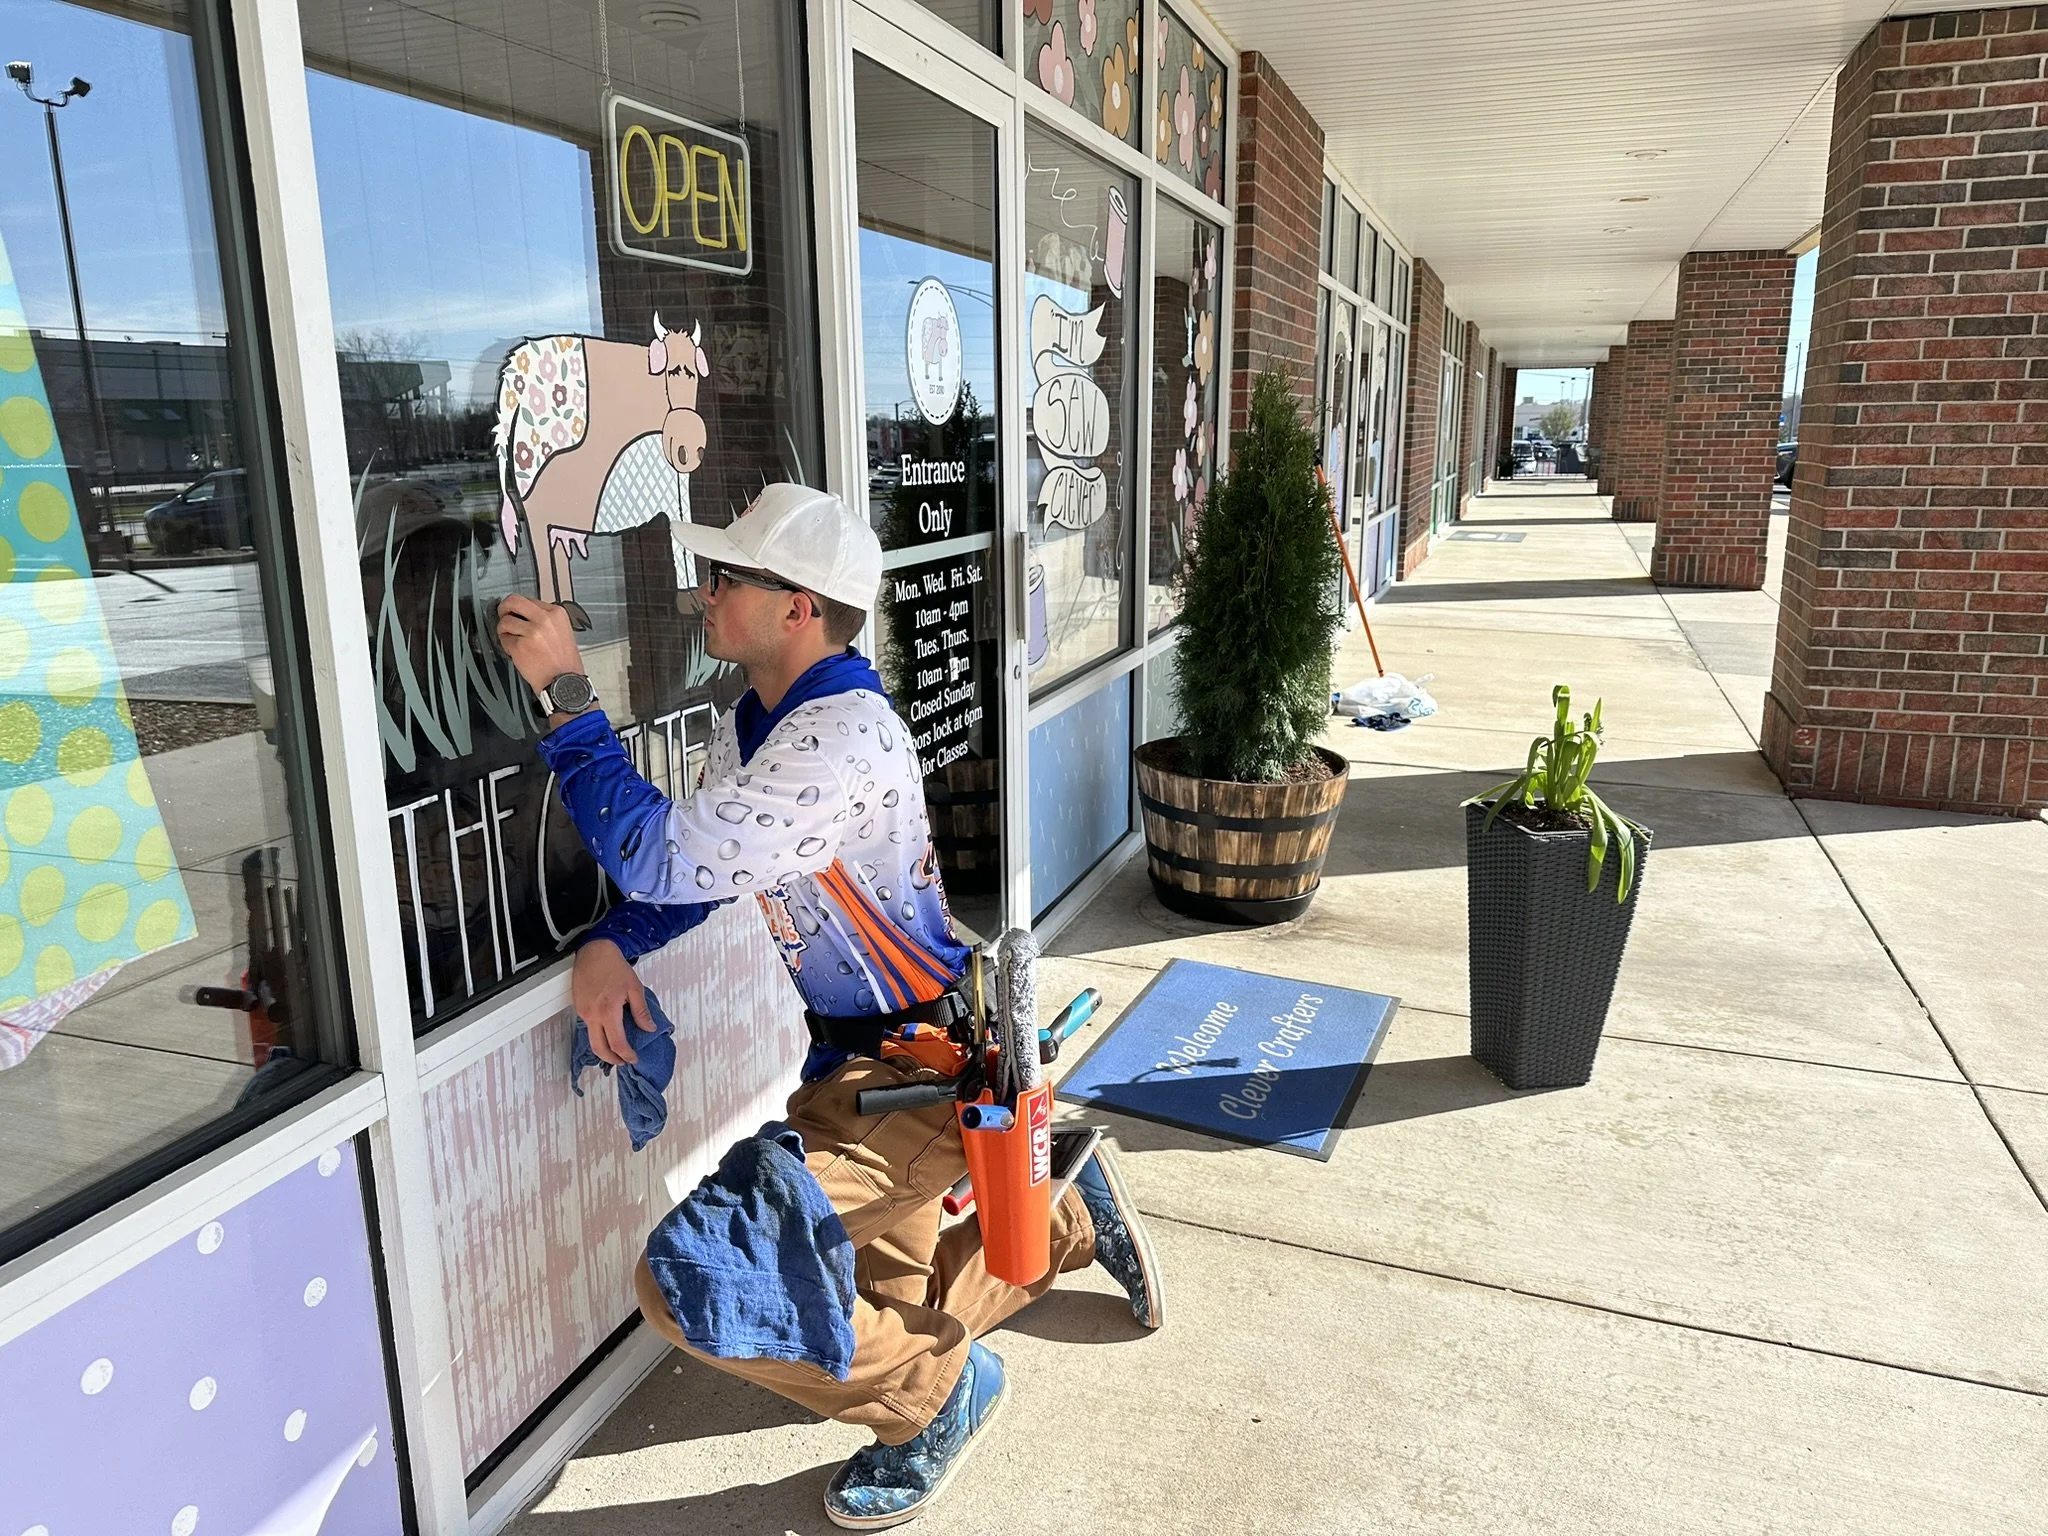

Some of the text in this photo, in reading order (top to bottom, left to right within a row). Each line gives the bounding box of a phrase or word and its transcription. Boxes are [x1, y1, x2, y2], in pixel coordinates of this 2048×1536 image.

[619, 124, 747, 252] OPEN
[901, 454, 965, 486] Entrance
[919, 500, 953, 538] Only
[894, 564, 983, 603] Mon. Wed. Fri. Sat.
[915, 607, 942, 629] 10am
[948, 600, 969, 622] 4pm
[914, 628, 970, 660] Tues. Thurs.
[916, 667, 943, 690] 10am
[910, 680, 976, 722] Closed Sunday
[911, 705, 983, 753] oors lock at 6pm
[921, 740, 969, 778] for Classes
[387, 764, 540, 1019] THE
[1156, 1000, 1239, 1075] Welcome
[1218, 992, 1325, 1121] Clever Crafters
[1032, 1124, 1049, 1184] WCR
